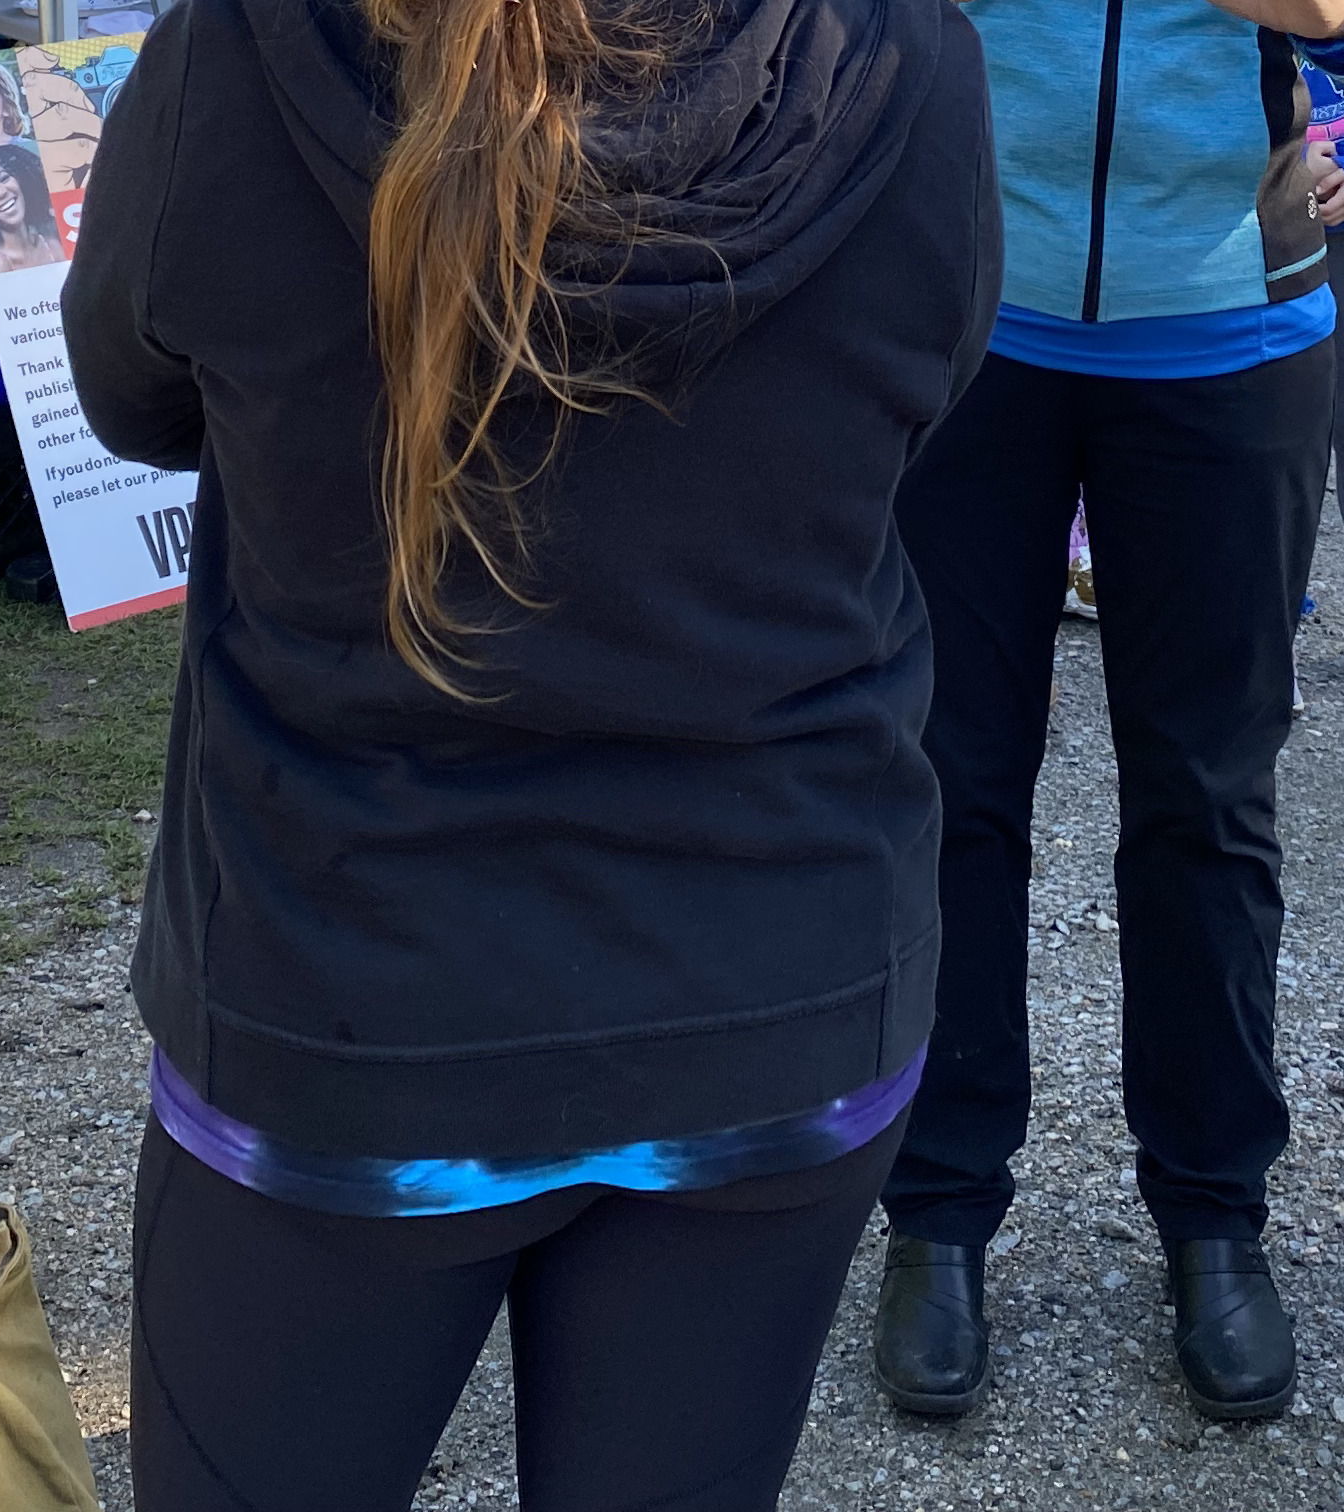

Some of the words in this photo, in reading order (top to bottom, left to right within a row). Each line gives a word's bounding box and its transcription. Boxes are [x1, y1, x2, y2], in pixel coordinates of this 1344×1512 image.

[4, 306, 27, 321] We
[10, 326, 63, 345] various
[17, 356, 64, 376] Thank
[31, 403, 80, 428] gained
[38, 430, 76, 450] other
[45, 468, 56, 482] If
[57, 463, 83, 482] you
[84, 457, 102, 472] do
[52, 486, 100, 509] please
[102, 478, 122, 494] let
[124, 474, 148, 488] our
[136, 501, 196, 579] VP
